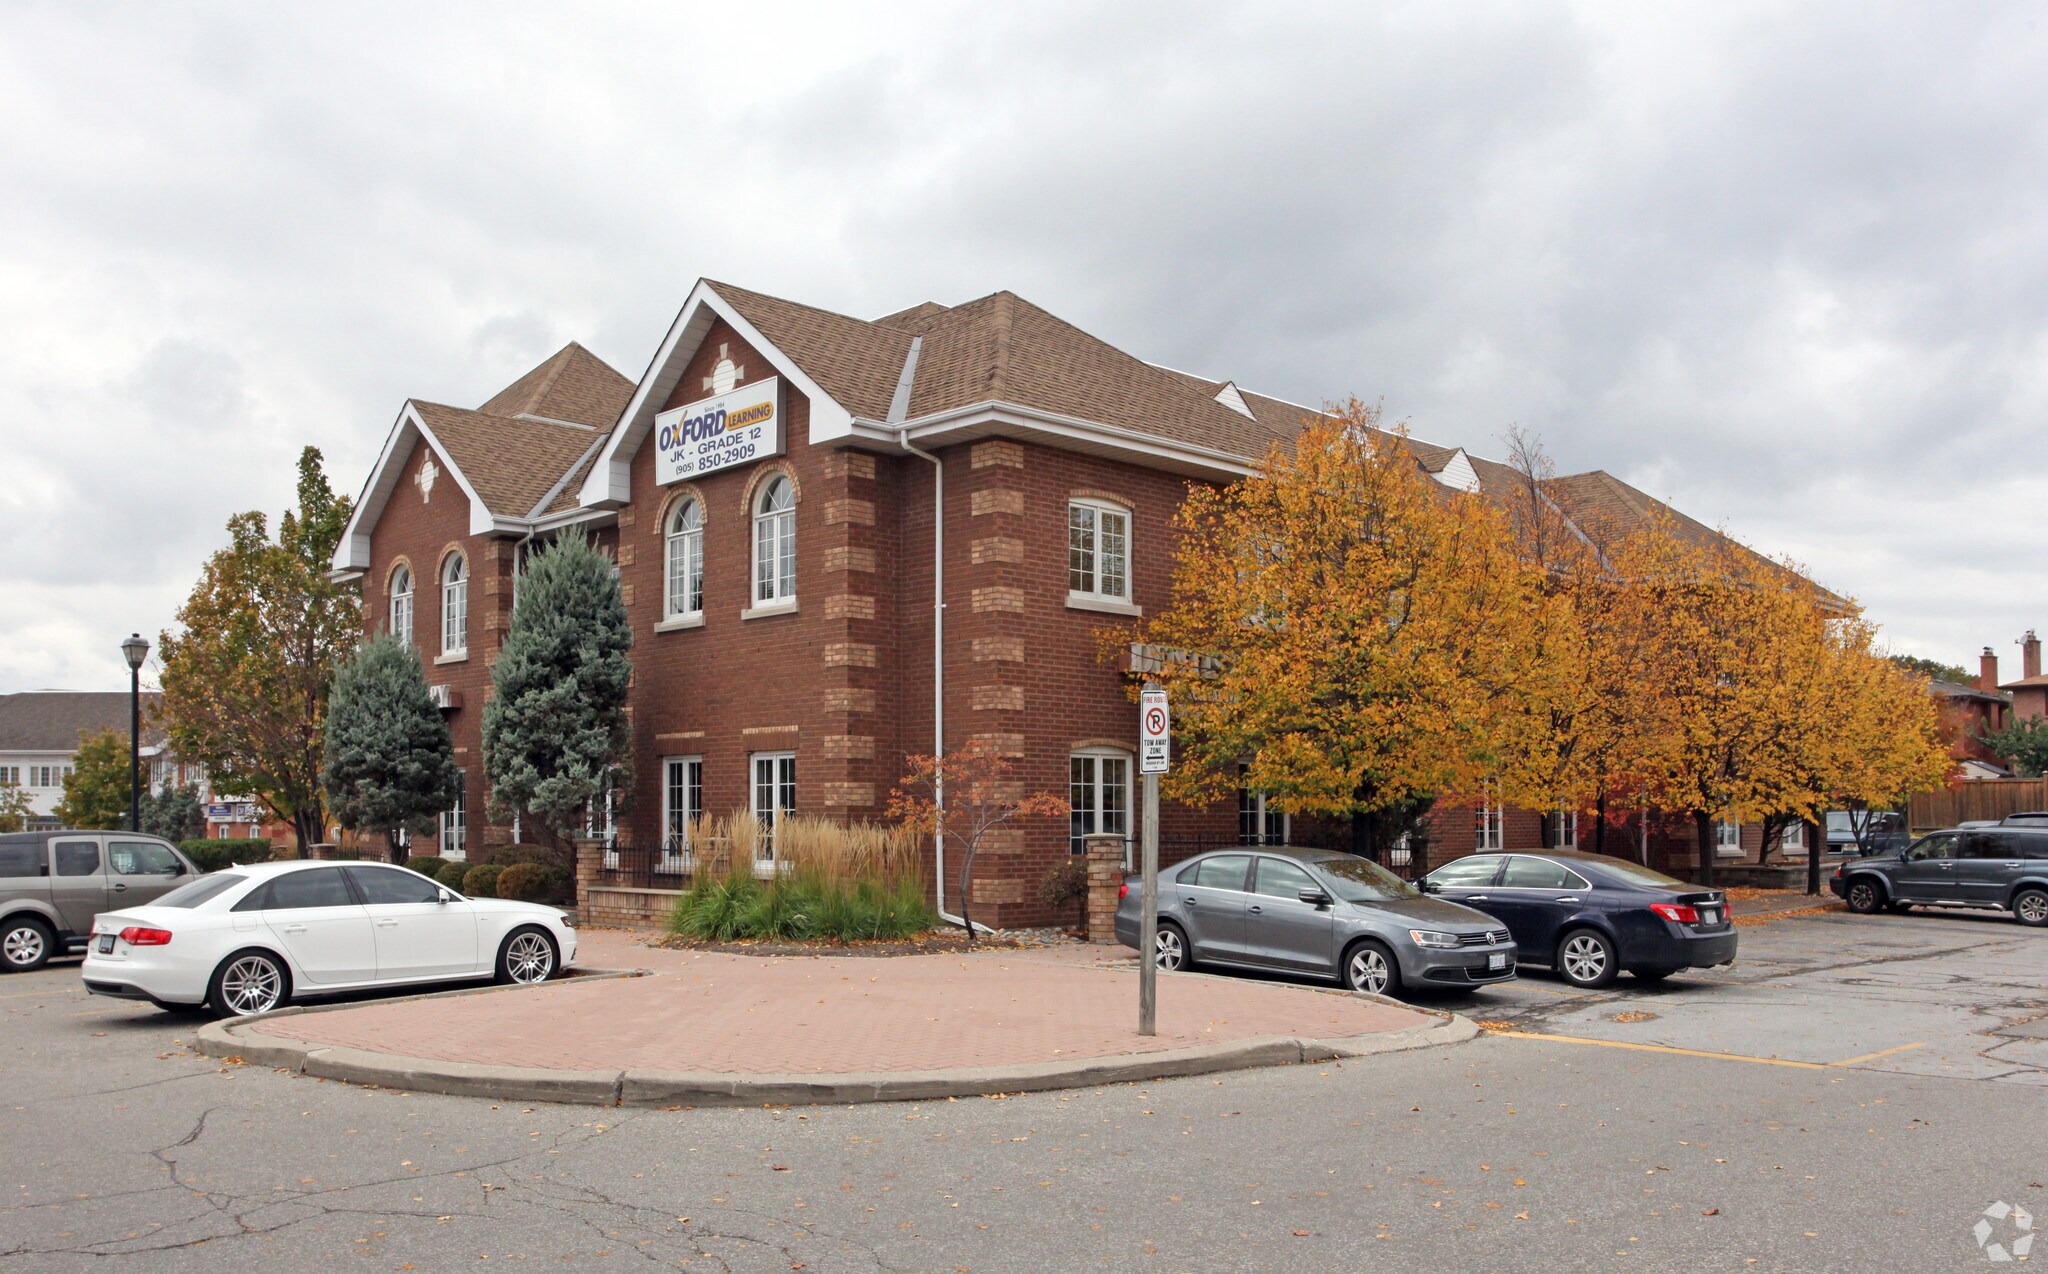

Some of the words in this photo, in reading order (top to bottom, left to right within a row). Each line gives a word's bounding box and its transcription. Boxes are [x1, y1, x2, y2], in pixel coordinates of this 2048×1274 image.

[660, 409, 727, 451] OXFORD
[728, 404, 771, 428] LEARNING
[671, 449, 685, 462] JK
[698, 432, 743, 455] GRADE
[749, 427, 761, 439] 12
[676, 462, 694, 475] (905)
[698, 443, 755, 471] 850-2909
[1155, 738, 1167, 746] AWAY
